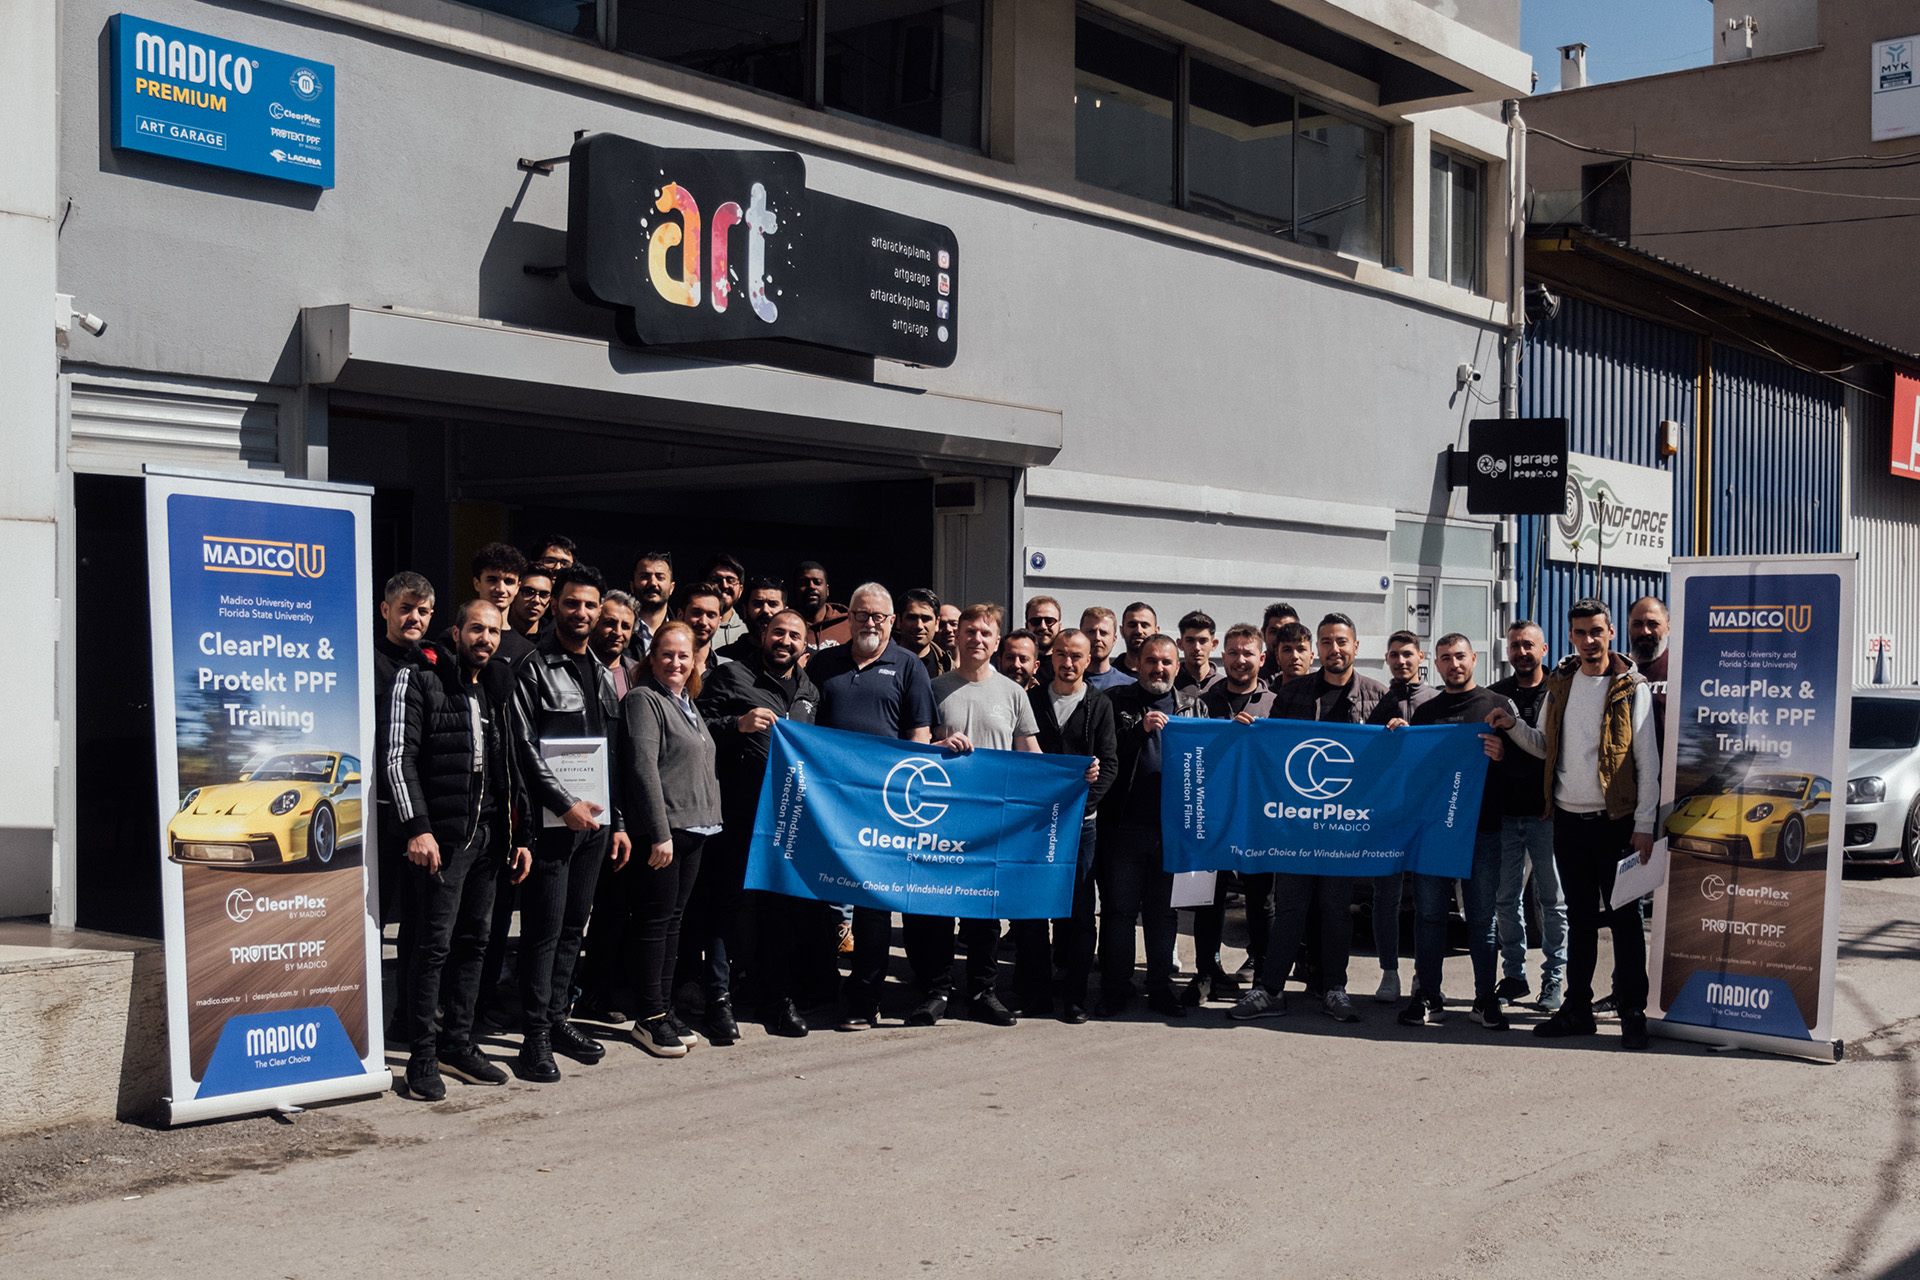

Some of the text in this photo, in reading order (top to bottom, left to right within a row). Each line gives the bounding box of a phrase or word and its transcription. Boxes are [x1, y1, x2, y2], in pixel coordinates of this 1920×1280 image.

[136, 32, 252, 94] MADICO
[1881, 61, 1909, 73] MYK
[136, 77, 226, 113] PREMIUM
[284, 109, 321, 124] ClearPlex
[140, 120, 223, 147] ART GARAGE
[306, 135, 321, 145] PPF
[648, 181, 778, 324] art
[871, 237, 931, 261] artarackaplama
[894, 268, 931, 287] artgarage
[870, 289, 930, 311] artarackaplama
[892, 319, 929, 338] artgarage
[1513, 454, 1558, 467] garage
[1589, 501, 1668, 534] WNDFORCE
[1626, 532, 1664, 549] TIRES
[220, 595, 311, 610] Madico University and
[219, 608, 314, 624] Florida State University
[199, 632, 335, 660] ClearPlex &
[1747, 651, 1781, 660] University
[1762, 661, 1798, 670] University
[199, 667, 337, 693] Protekt PPF
[1700, 679, 1815, 699] ClearPlex &
[224, 703, 314, 733] Training
[1697, 706, 1816, 726] Protekt PPF
[1716, 733, 1792, 759] Training
[1183, 752, 1192, 801] Protection
[1195, 746, 1205, 840] Invisible Windshield
[1445, 771, 1462, 828] clearplex.com
[773, 766, 796, 847] Protection Films
[784, 760, 807, 861] Invisible Windshield
[1263, 801, 1370, 821] ClearPlex
[1045, 803, 1060, 863] clearplex.com
[1313, 822, 1371, 832] BY MADICO
[858, 828, 966, 853] ClearPlex
[907, 853, 965, 865] BY MADICO
[1230, 845, 1405, 858] The Clear Choice for Windshield Protection
[1619, 853, 1640, 875] MADIC
[818, 873, 1000, 898] The Clear Choice for Windshield Protection
[1726, 883, 1790, 900] ClearPlex
[255, 895, 326, 913] ClearPlex
[299, 910, 327, 918] MADICO
[1701, 918, 1786, 938] PROTEKT PPF
[230, 940, 326, 964] PROTEKT PPF
[1757, 939, 1785, 948] MADICO
[285, 960, 327, 971] BY MADICO
[196, 983, 359, 1007] madico.com.tr clearplex.com.tr protektppf.com.tr
[1707, 983, 1769, 1010] MADICO
[1712, 1007, 1762, 1020] The Clear Choice
[247, 1023, 317, 1056] MADICO
[255, 1055, 311, 1068] The Clear Choice
